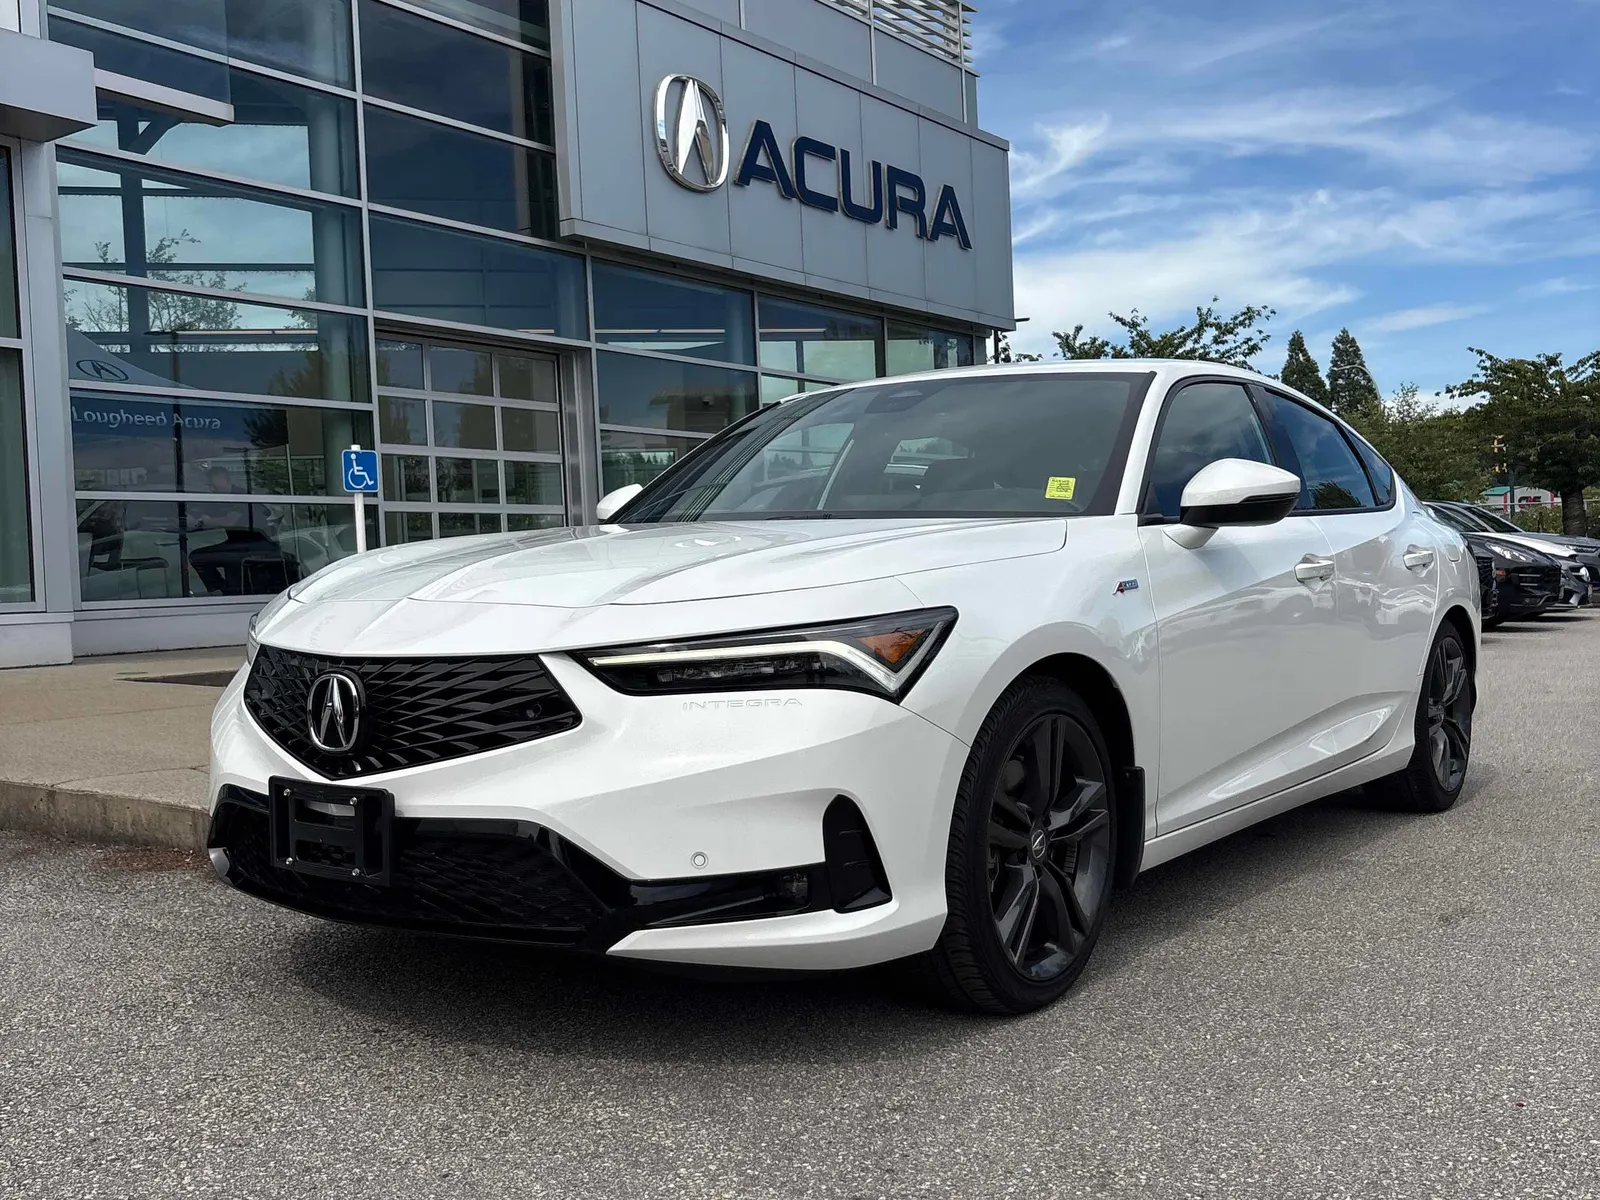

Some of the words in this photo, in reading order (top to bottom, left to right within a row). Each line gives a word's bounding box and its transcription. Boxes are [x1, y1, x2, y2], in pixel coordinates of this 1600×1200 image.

[733, 119, 973, 251] ACURA
[72, 405, 167, 428] Lougheed
[172, 413, 221, 430] Acura
[682, 698, 803, 710] INTEGRA
